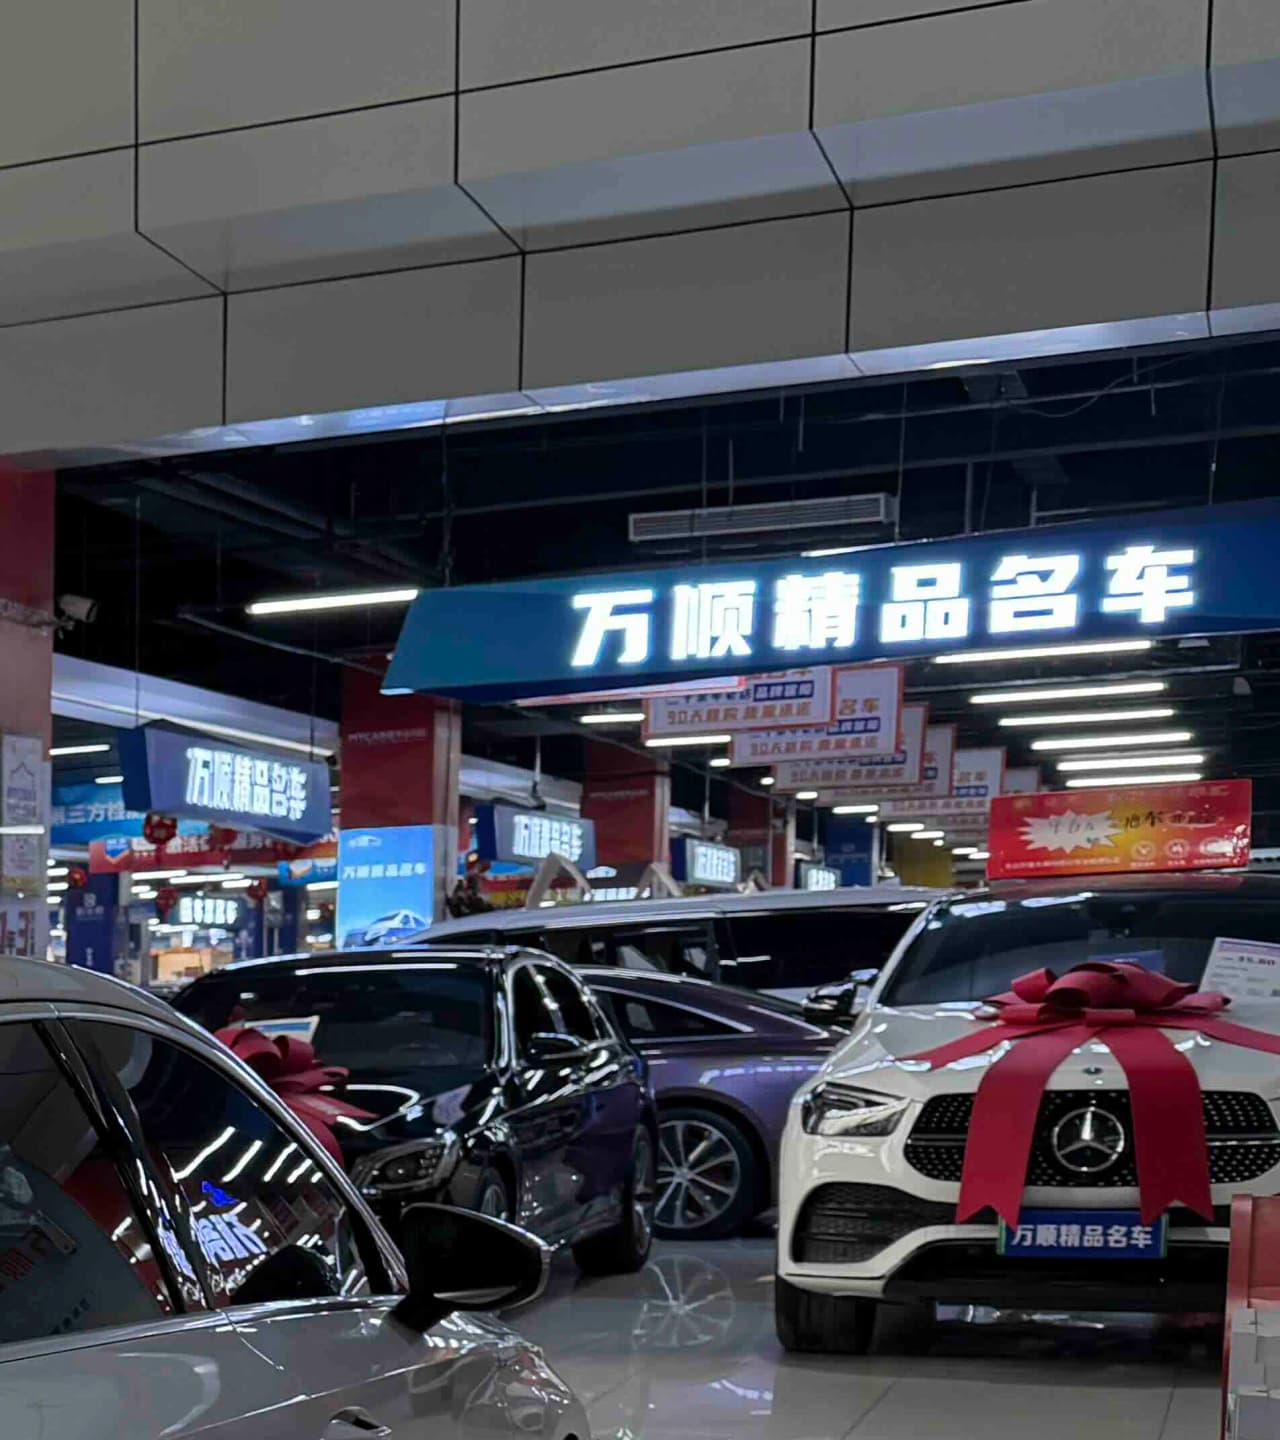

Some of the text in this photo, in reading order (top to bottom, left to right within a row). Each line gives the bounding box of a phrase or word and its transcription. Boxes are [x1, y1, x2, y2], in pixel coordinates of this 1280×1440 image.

[570, 544, 1197, 669] 万顺精品名车
[1010, 1222, 1153, 1249] 万顺精品名车
